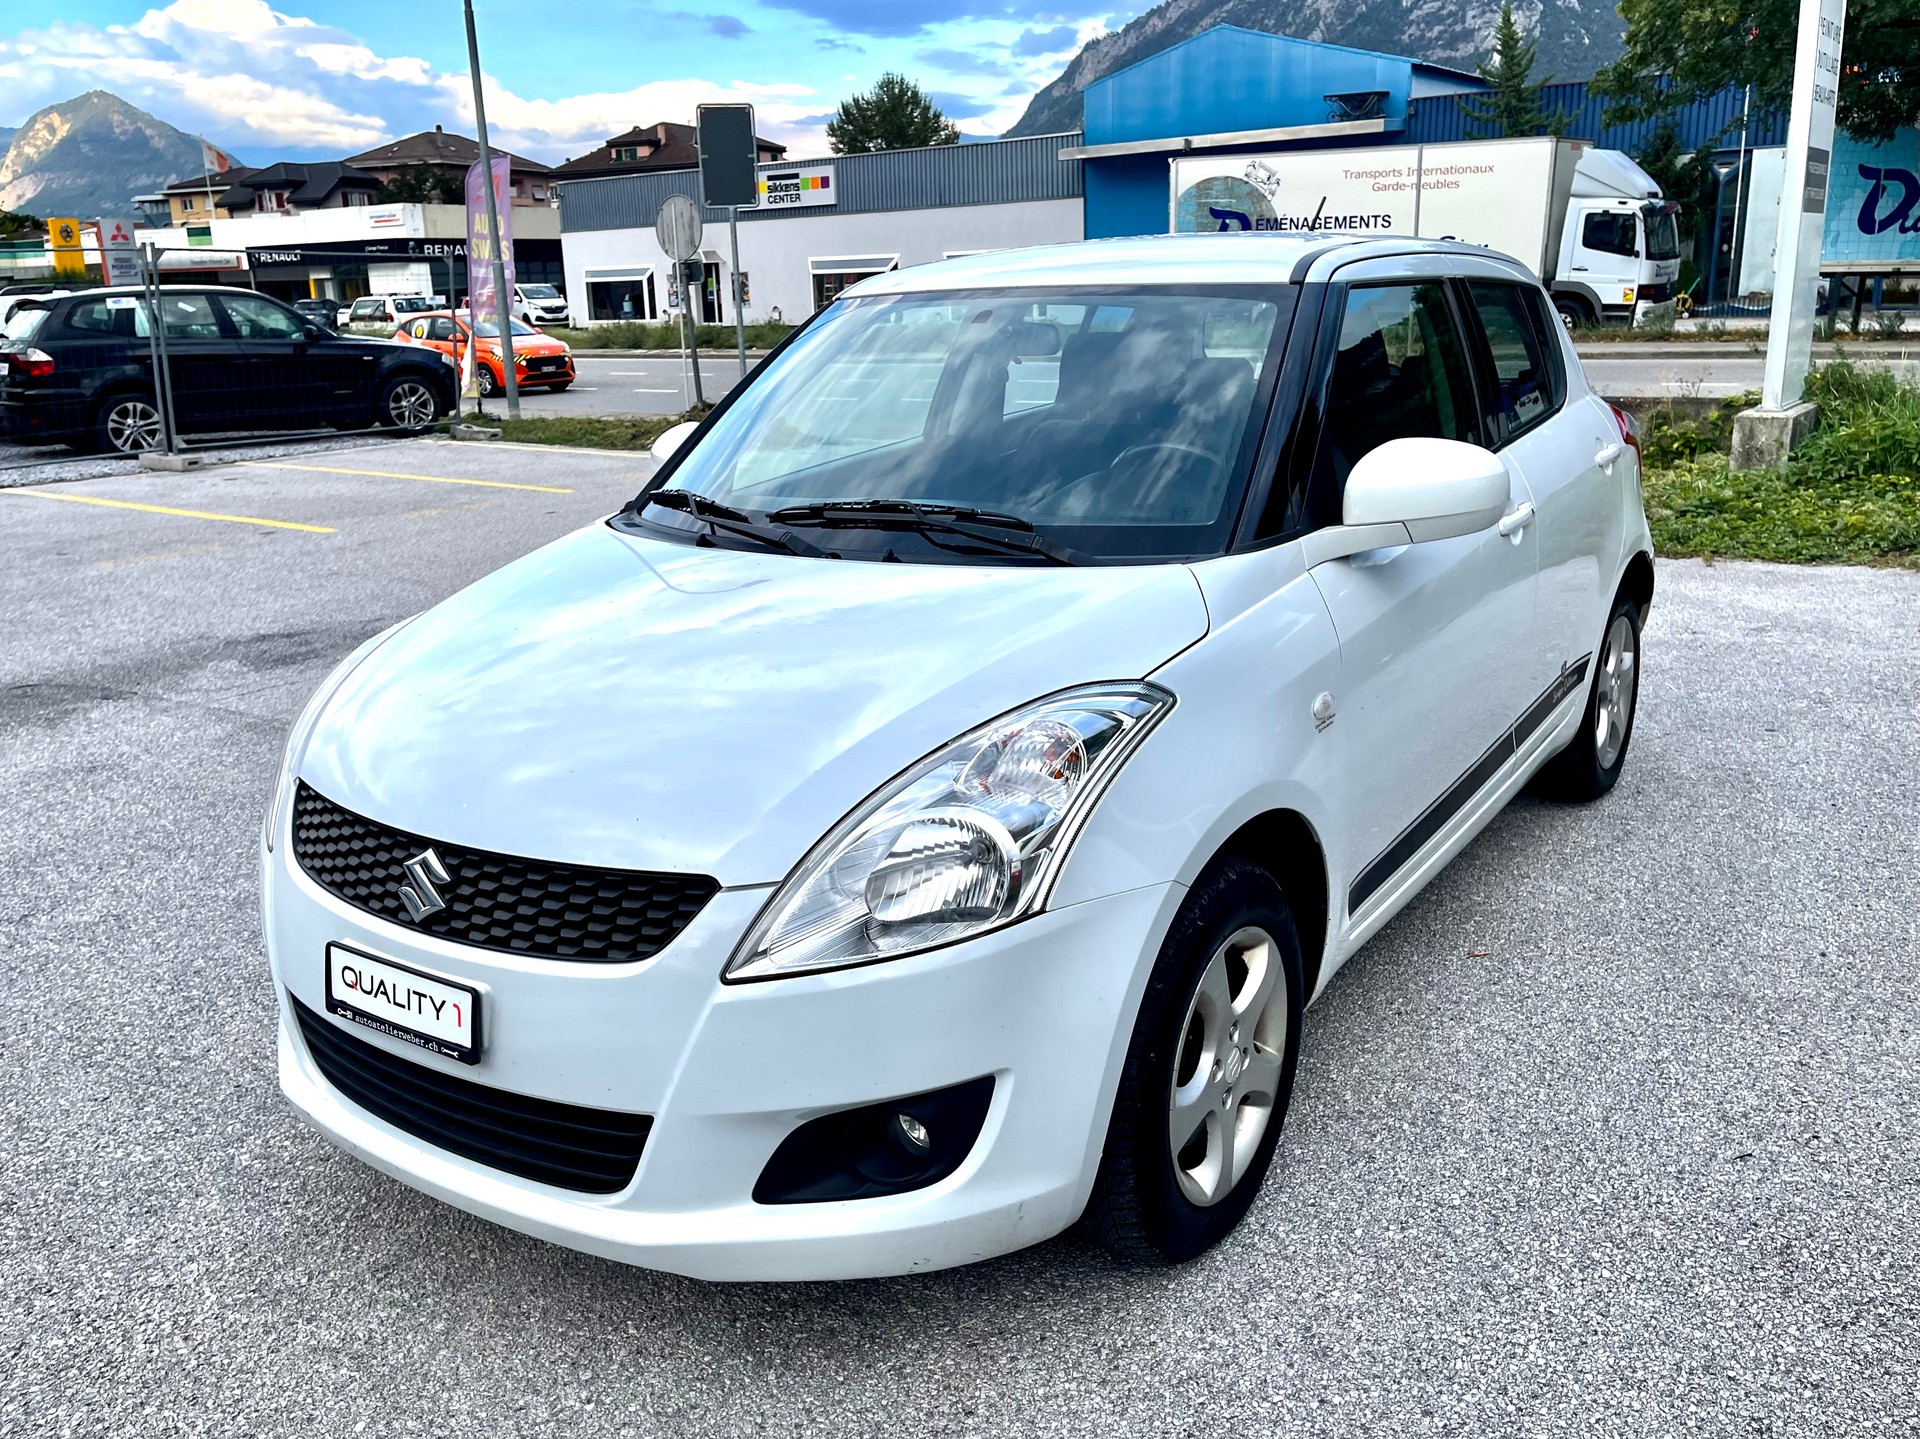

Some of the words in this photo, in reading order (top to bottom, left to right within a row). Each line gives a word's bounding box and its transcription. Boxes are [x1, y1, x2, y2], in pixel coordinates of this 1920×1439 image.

[1342, 168, 1403, 180] Transports
[767, 181, 800, 194] sikkens
[768, 193, 801, 204] CENTER
[474, 213, 504, 236] AUO
[341, 965, 447, 1021] QUALITY
[453, 1002, 461, 1028] 1
[355, 1014, 439, 1052] autoatelierweber.ch
